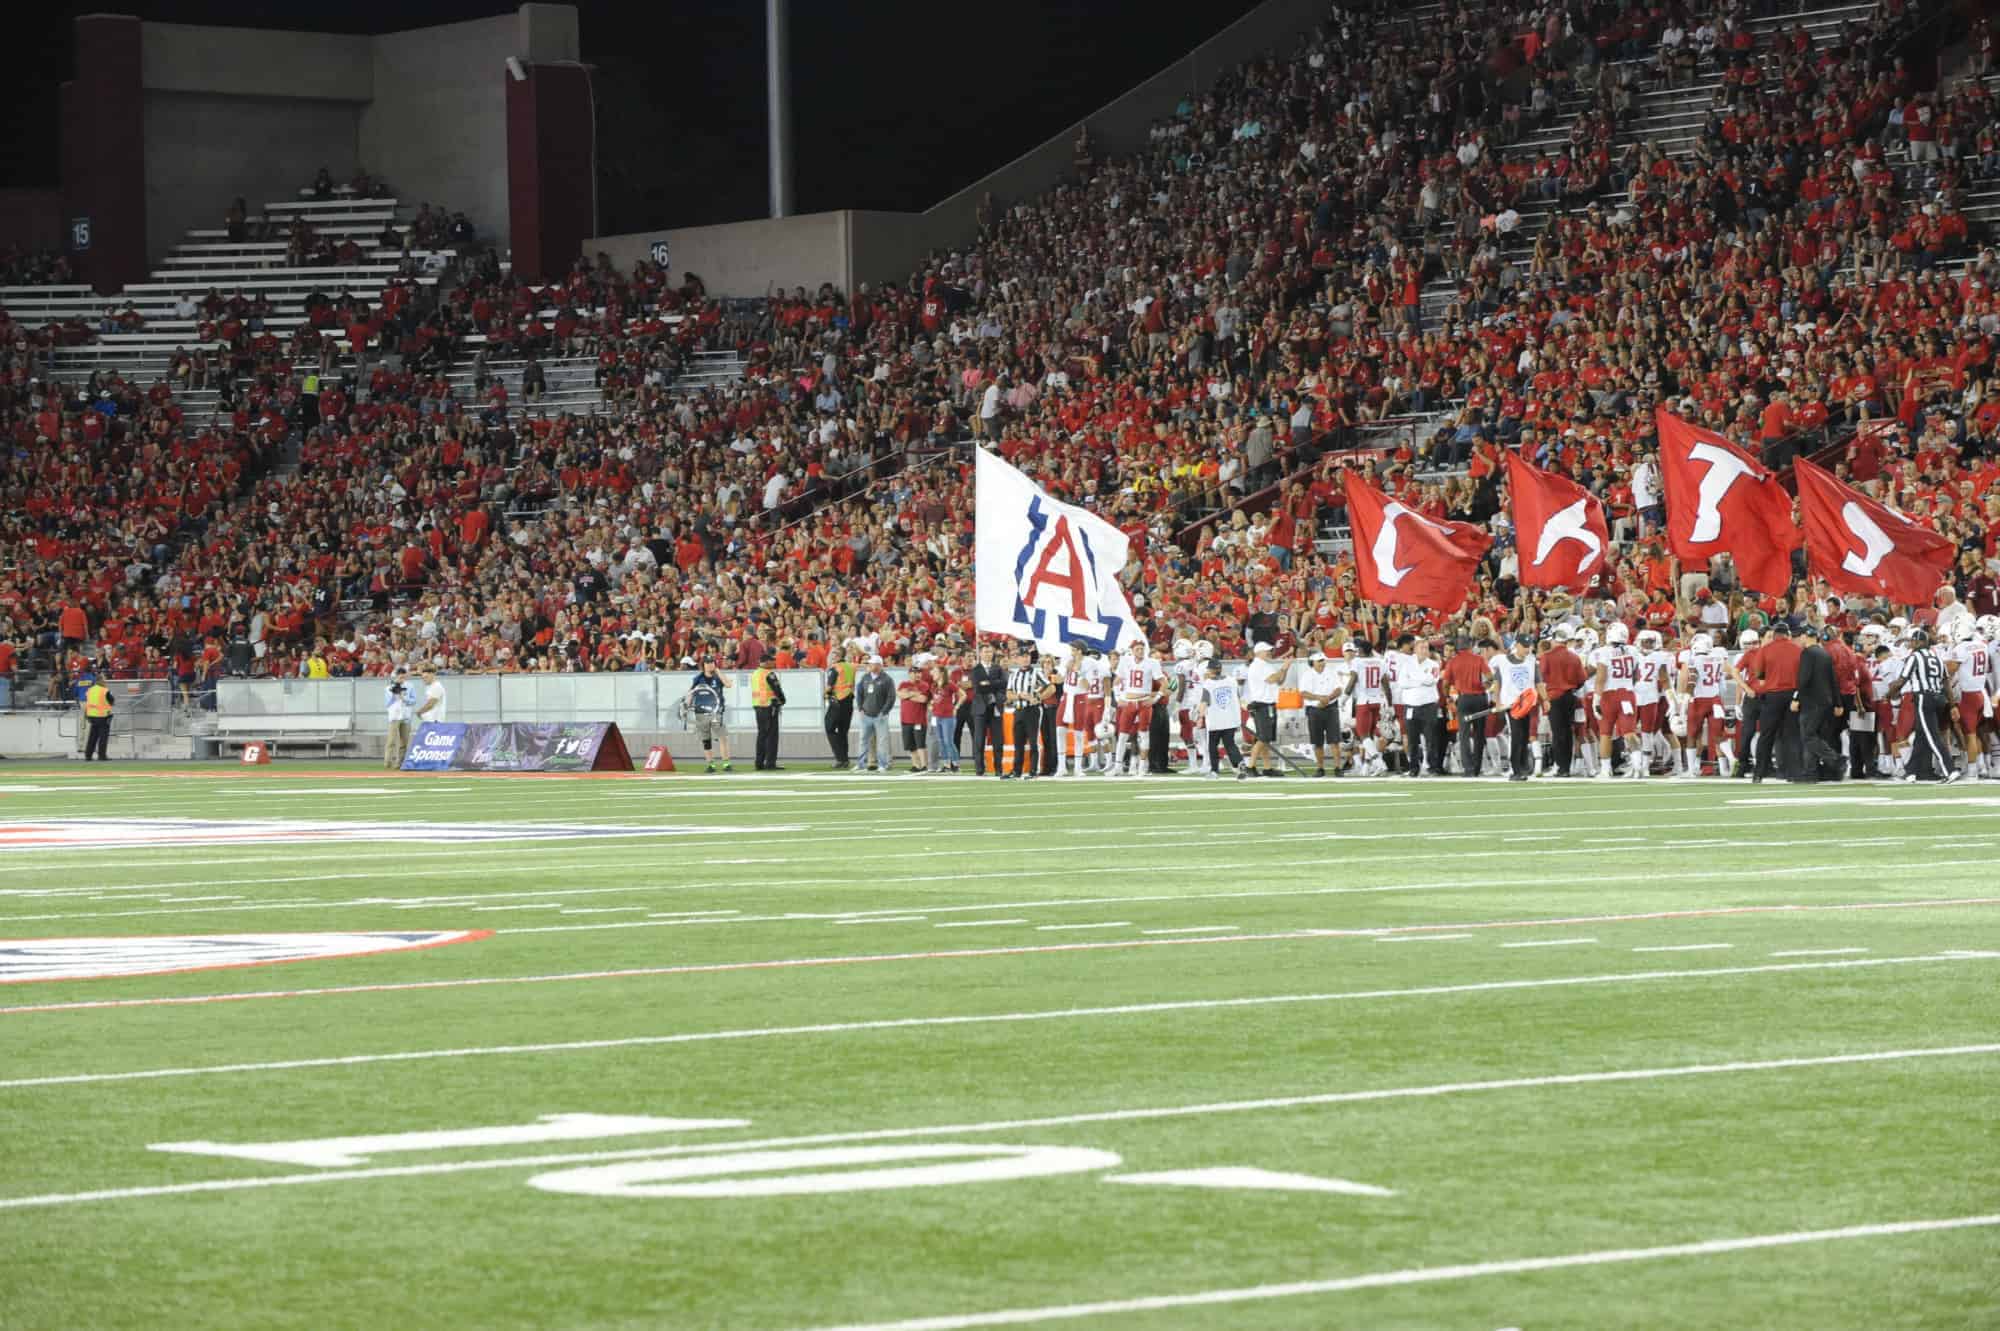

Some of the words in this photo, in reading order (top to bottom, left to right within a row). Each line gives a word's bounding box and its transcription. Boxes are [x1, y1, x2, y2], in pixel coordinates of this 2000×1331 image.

[72, 223, 88, 244] 15
[651, 245, 668, 266] 16
[1688, 442, 1765, 543] T
[1130, 670, 1144, 688] 18
[1365, 666, 1380, 688] 10
[424, 730, 456, 747] Game
[244, 746, 260, 762] G
[409, 746, 455, 763] Sponsor
